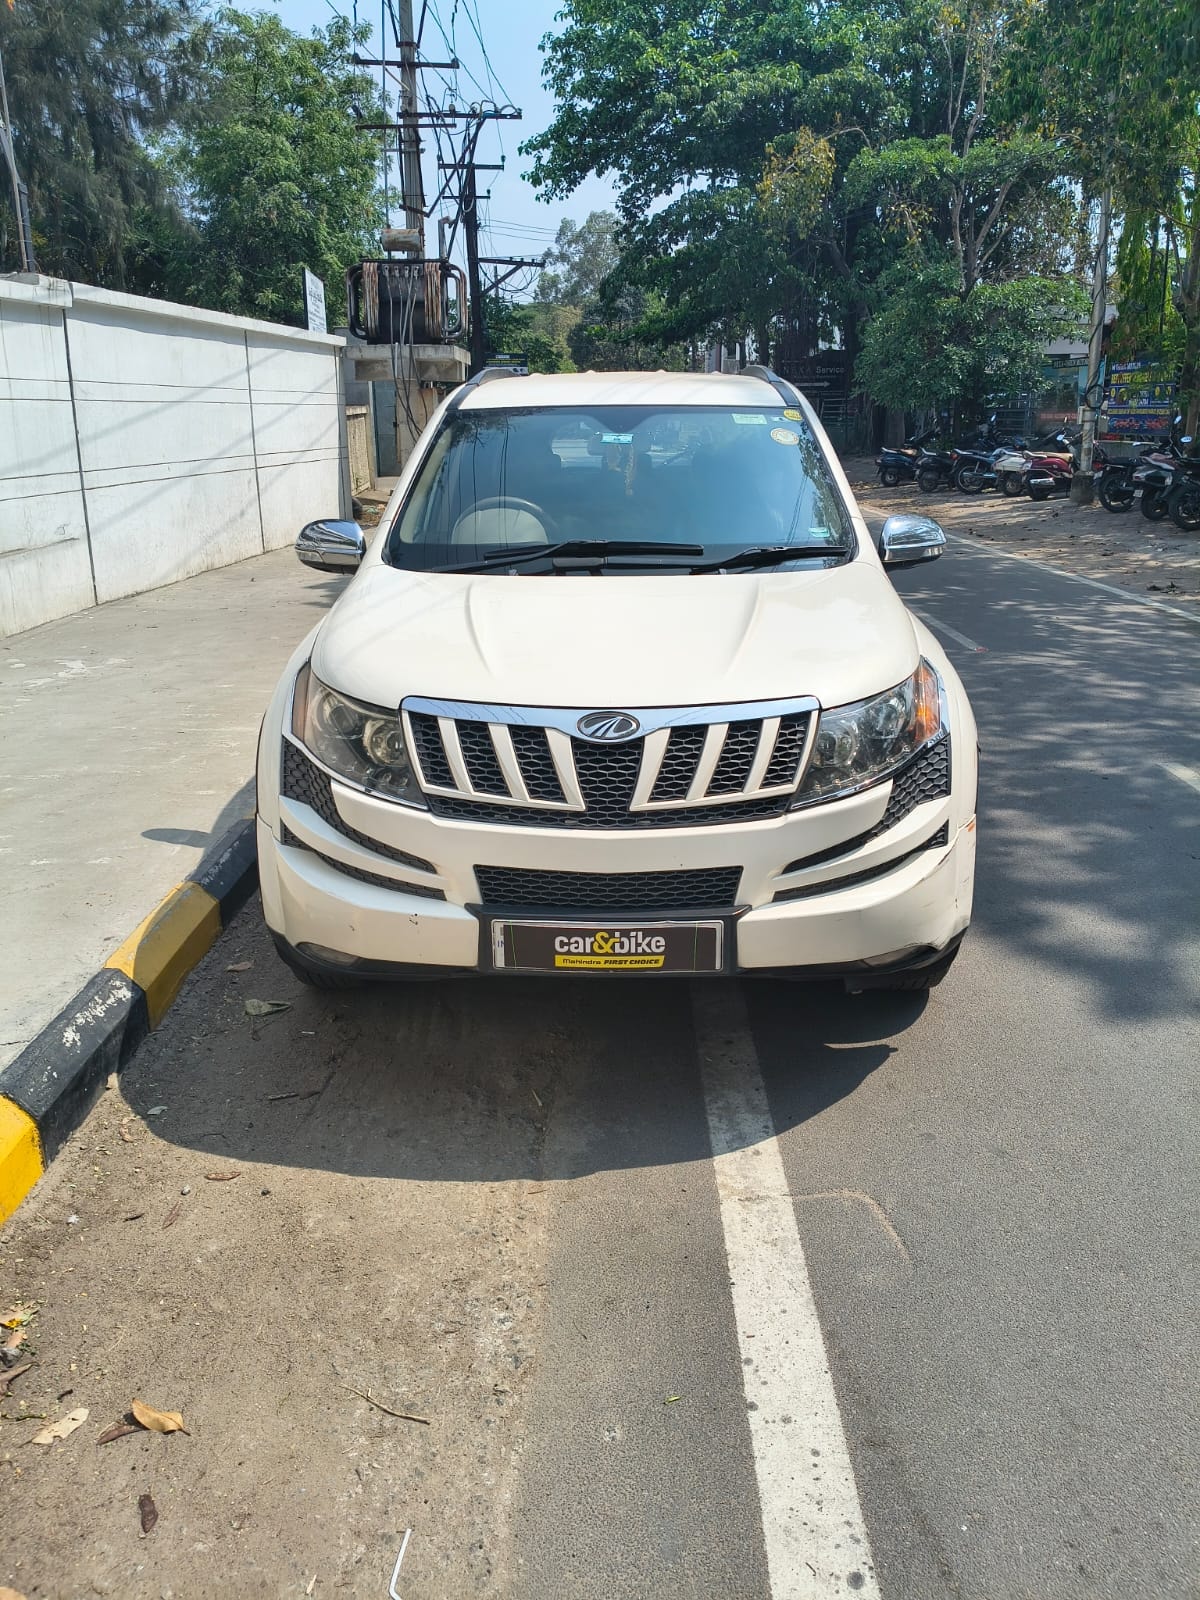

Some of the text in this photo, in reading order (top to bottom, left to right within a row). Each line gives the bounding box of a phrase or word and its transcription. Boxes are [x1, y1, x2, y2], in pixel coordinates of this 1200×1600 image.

[816, 366, 845, 374] Service
[554, 931, 666, 954] car&bike
[562, 958, 602, 966] Mahindra
